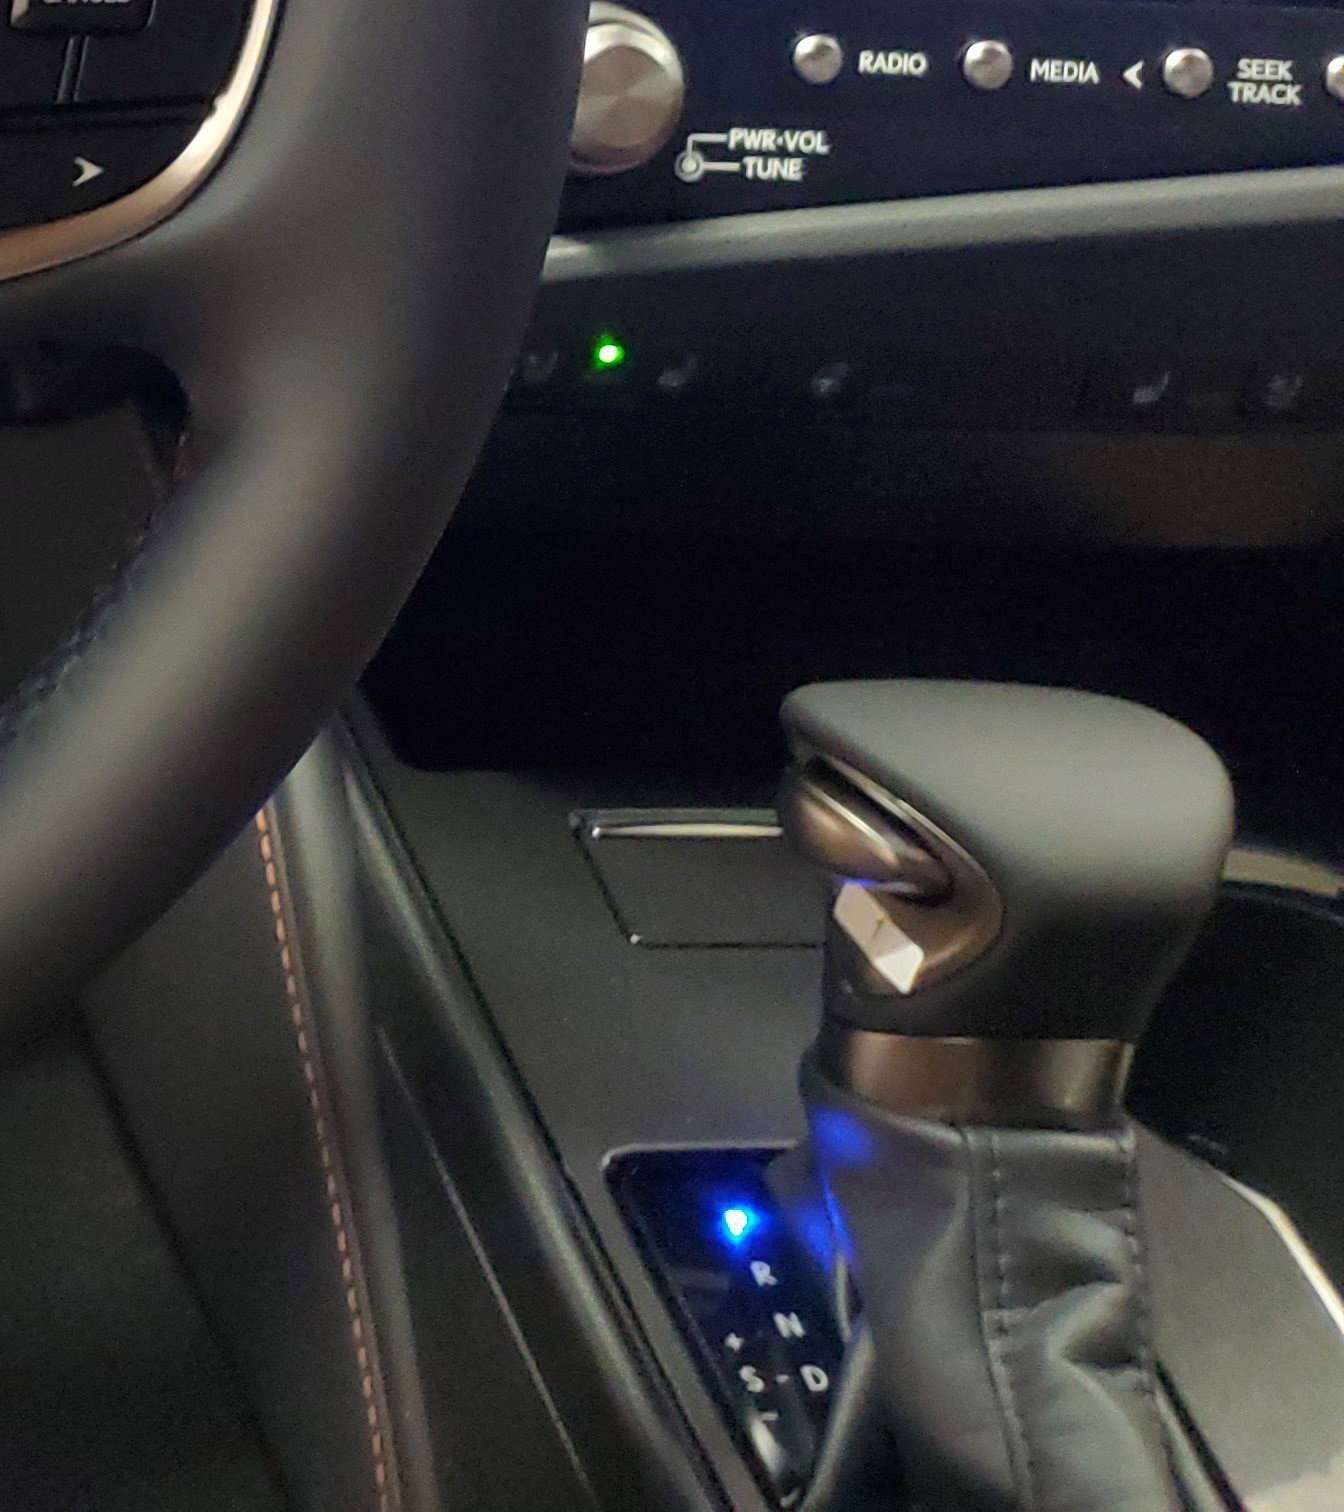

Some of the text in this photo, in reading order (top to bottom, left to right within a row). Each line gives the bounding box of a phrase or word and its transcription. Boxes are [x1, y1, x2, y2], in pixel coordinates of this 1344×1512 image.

[857, 50, 928, 76] RADIO
[1029, 58, 1100, 85] MEDIA
[1236, 57, 1294, 81] SEEK
[1226, 81, 1303, 106] TRACK
[742, 155, 805, 182] TUNE
[799, 1364, 829, 1392] D
